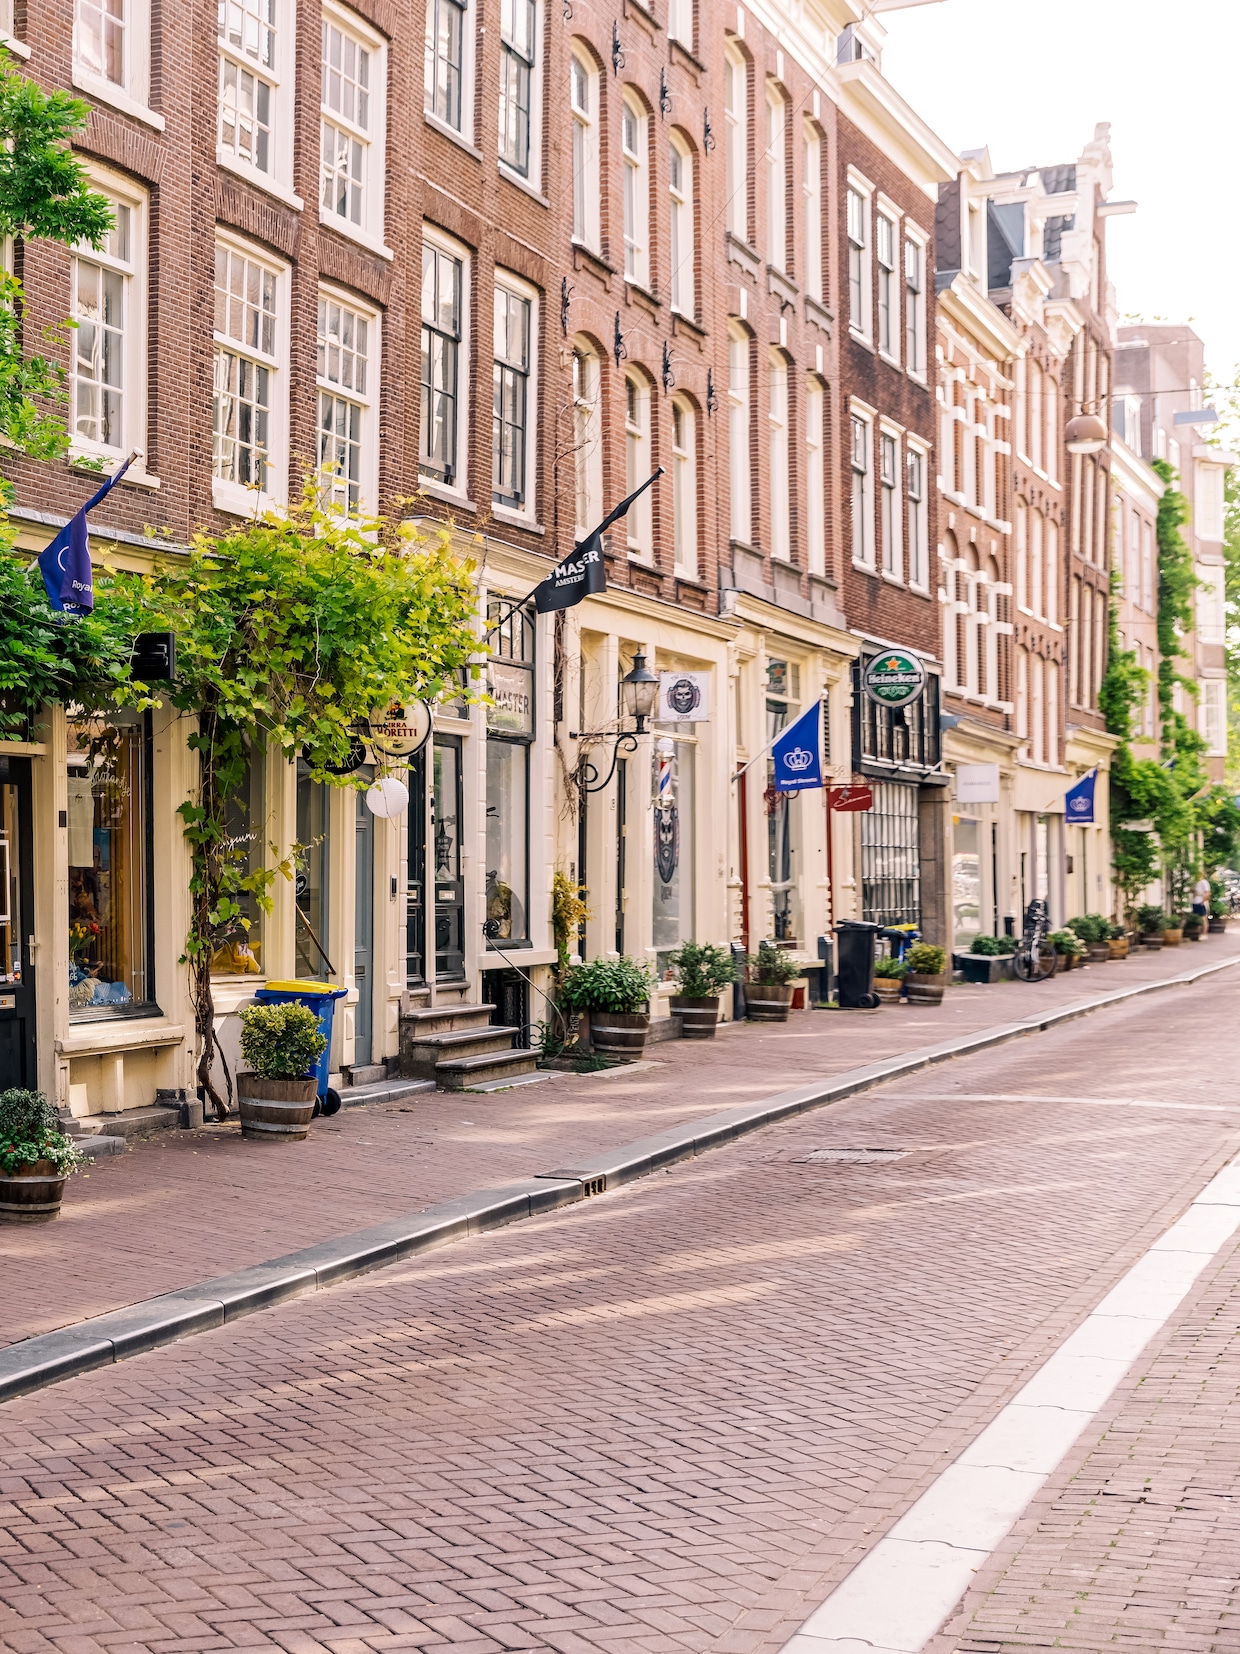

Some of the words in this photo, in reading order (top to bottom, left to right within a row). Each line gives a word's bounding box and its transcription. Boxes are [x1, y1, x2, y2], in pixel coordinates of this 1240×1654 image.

[555, 550, 601, 579] MASER
[867, 673, 920, 684] Heineken
[377, 726, 418, 737] MORETTI
